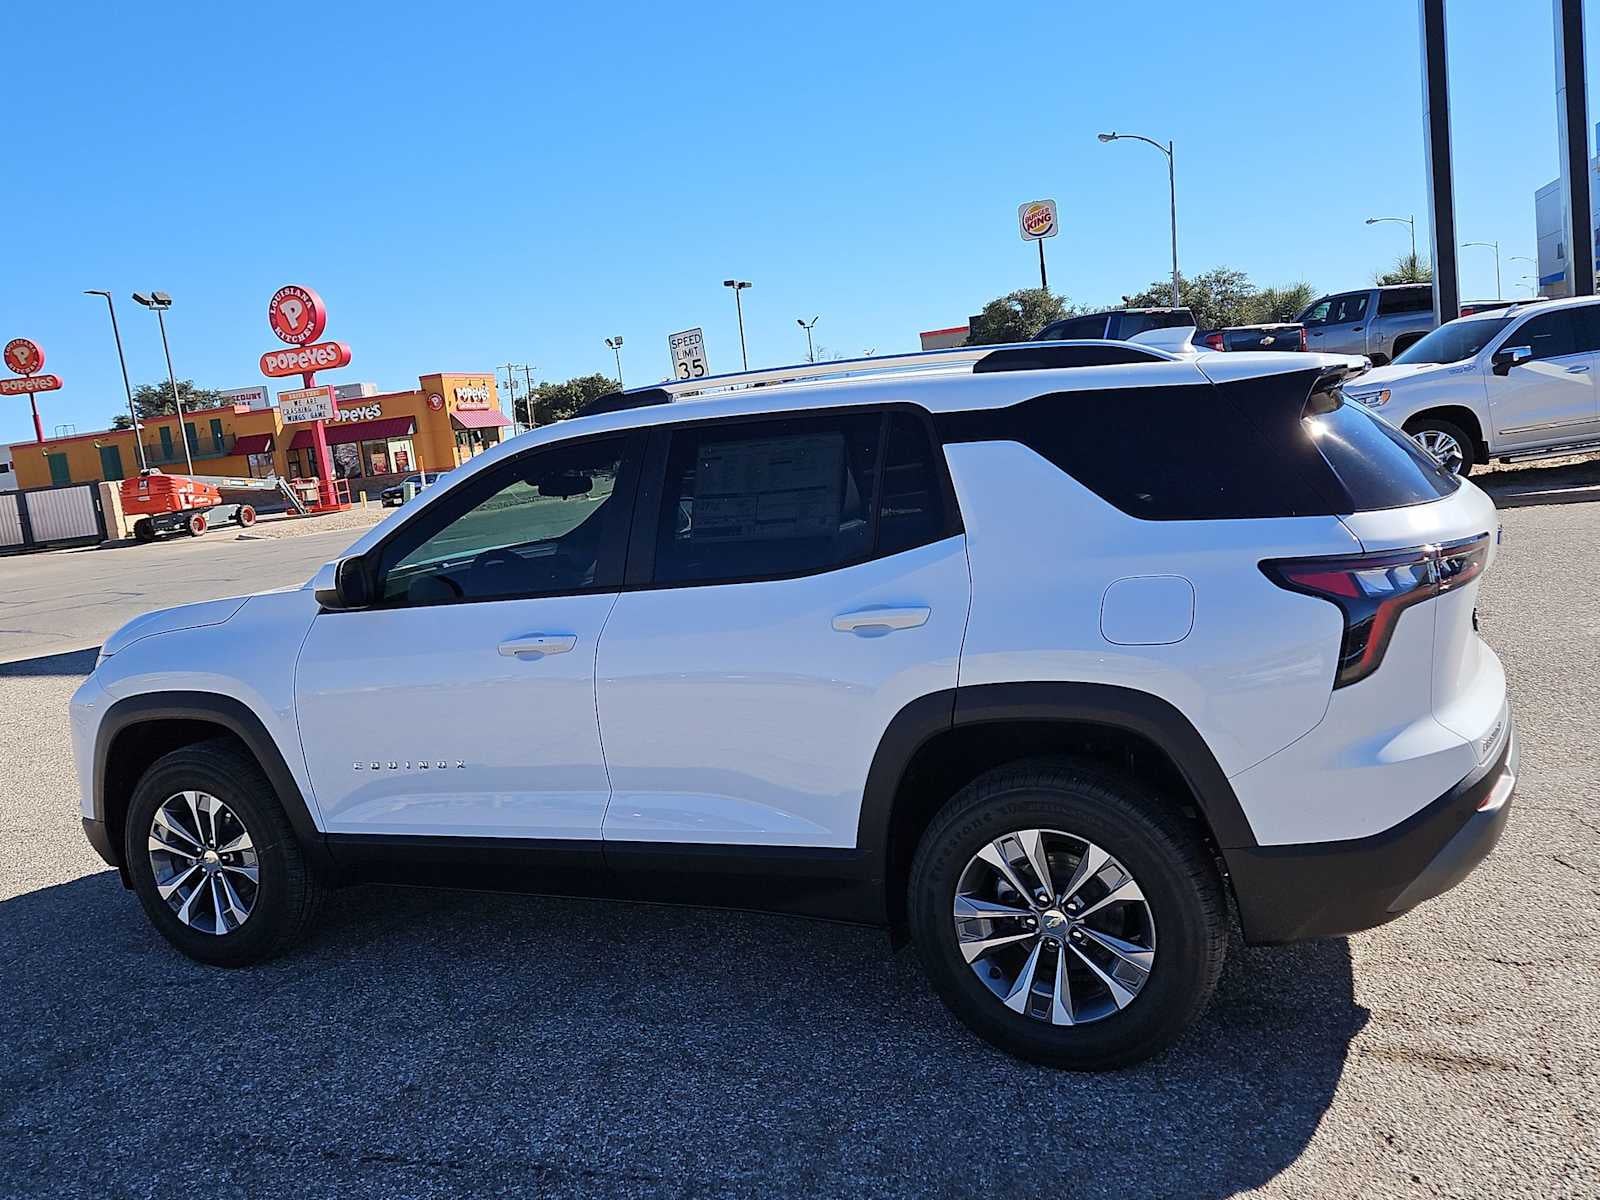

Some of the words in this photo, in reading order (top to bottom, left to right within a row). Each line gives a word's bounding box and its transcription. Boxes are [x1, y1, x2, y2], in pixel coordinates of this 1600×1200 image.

[1025, 207, 1050, 223] BURGER
[1027, 213, 1052, 231] KING
[270, 288, 313, 315] LOUISIANA
[275, 321, 315, 343] KITCHEN
[671, 334, 701, 349] SPEED
[676, 346, 698, 360] LIMIT
[678, 359, 705, 380] 35
[316, 403, 327, 411] THE
[353, 759, 466, 770] EQUINOX
